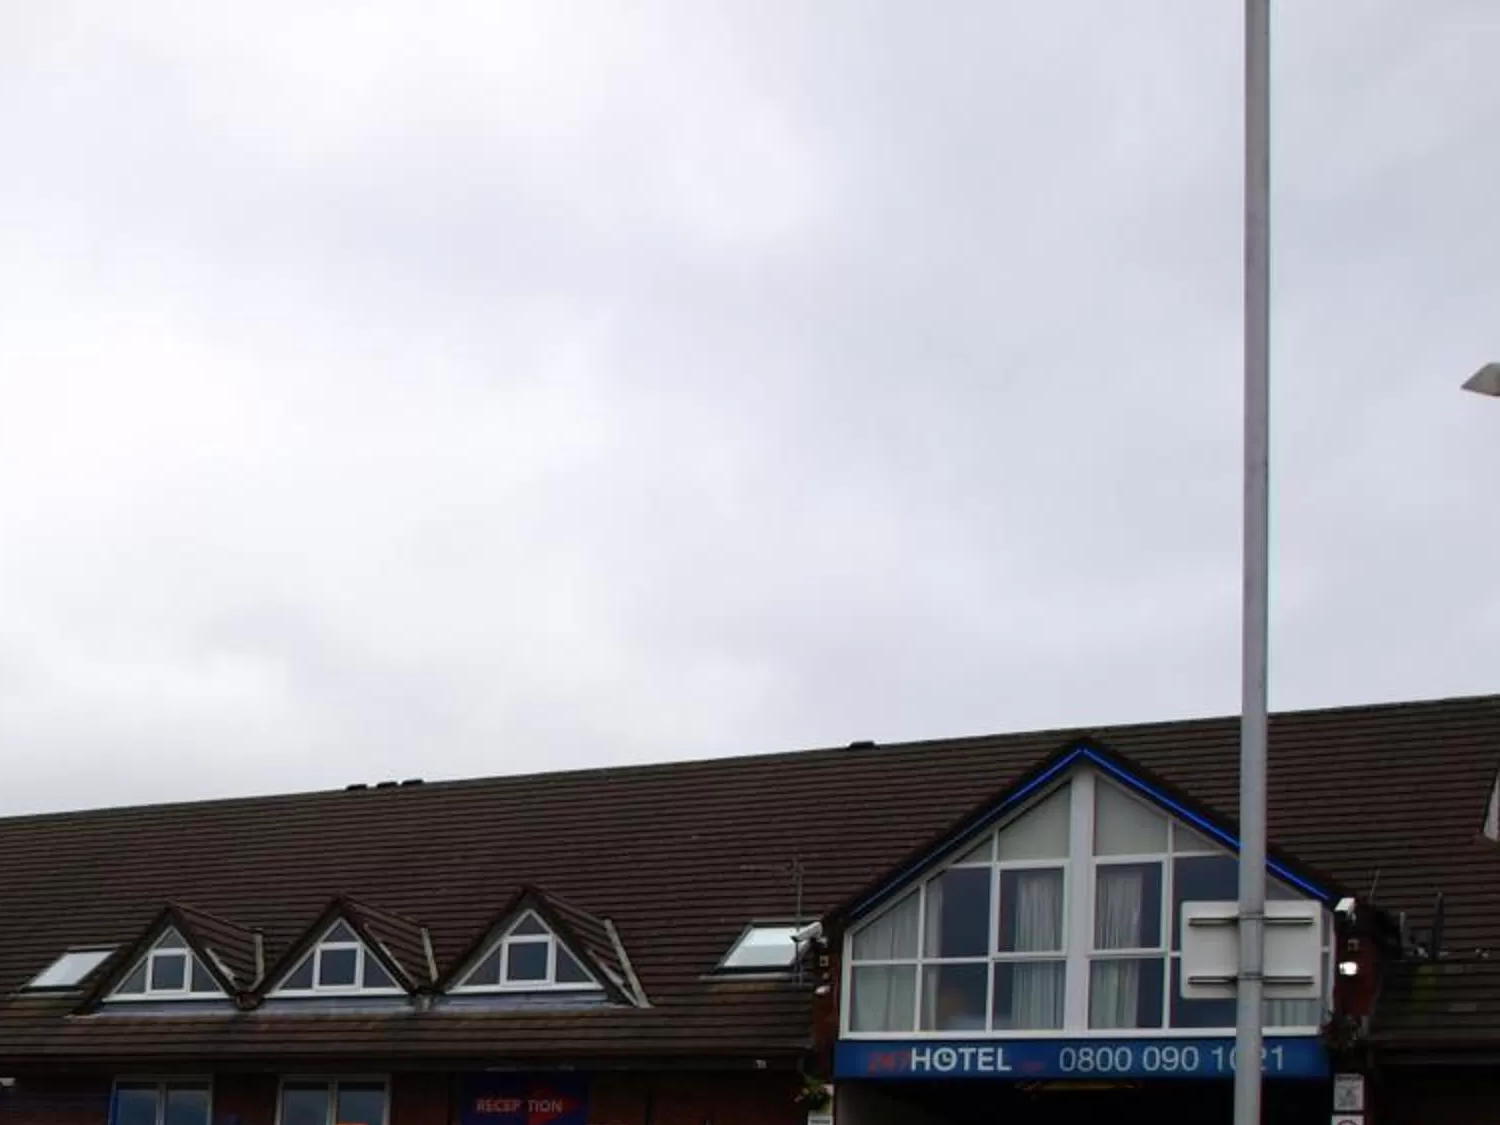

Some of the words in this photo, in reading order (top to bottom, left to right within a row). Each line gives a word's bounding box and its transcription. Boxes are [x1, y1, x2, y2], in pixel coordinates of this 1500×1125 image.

[911, 1047, 1012, 1072] HOTEL
[1059, 1047, 1132, 1072] 0800
[1142, 1046, 1199, 1072] 090
[1212, 1045, 1284, 1072] 11
